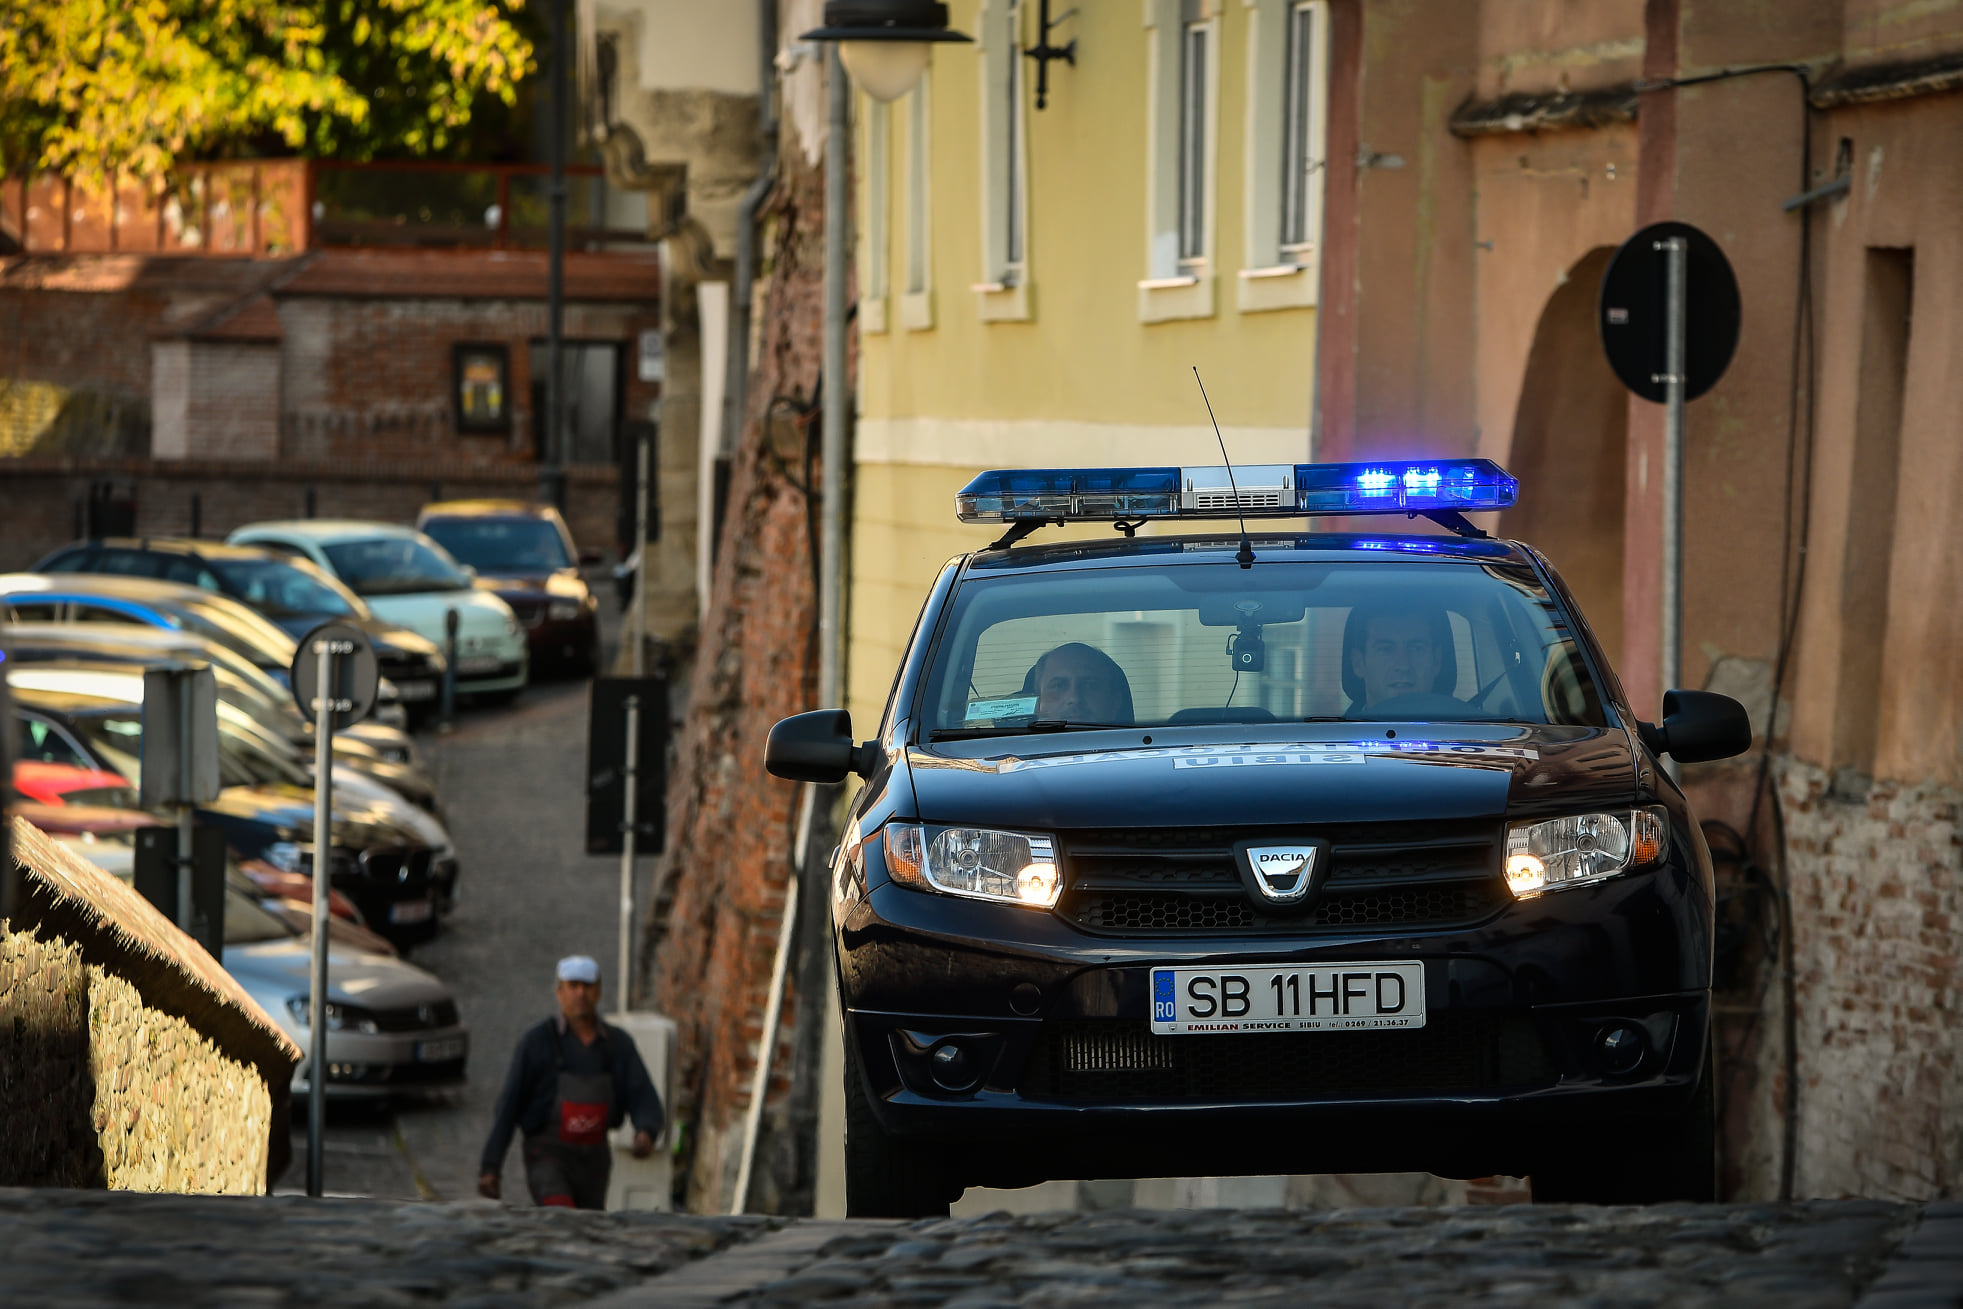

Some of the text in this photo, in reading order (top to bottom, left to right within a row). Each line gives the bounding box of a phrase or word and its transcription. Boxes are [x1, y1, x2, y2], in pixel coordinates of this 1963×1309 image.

[1260, 854, 1306, 862] DACIA
[1187, 975, 1251, 1017] SB
[1156, 1002, 1175, 1018] RO
[1243, 1022, 1291, 1030] SERVICE
